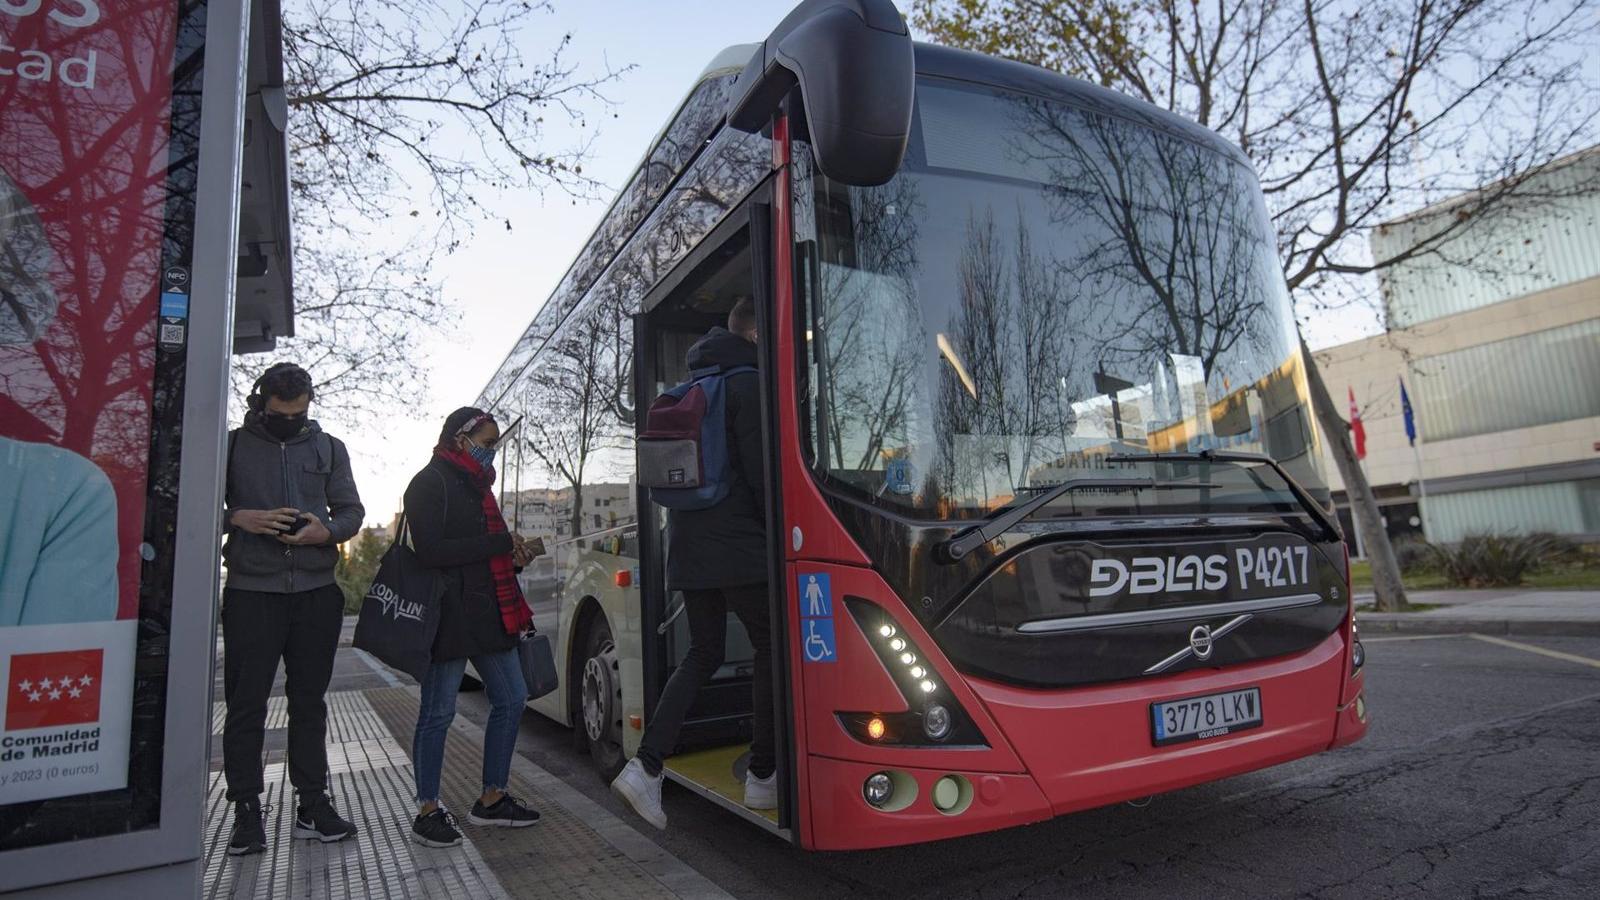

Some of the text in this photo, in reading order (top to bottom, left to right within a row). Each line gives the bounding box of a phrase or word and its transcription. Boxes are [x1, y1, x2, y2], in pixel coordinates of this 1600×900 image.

[168, 272, 186, 280] NFC
[1235, 546, 1308, 590] P4217
[1166, 692, 1255, 733] 3778 LKW
[2, 727, 101, 748] Comunidad
[1, 740, 99, 762] de Madrid
[12, 770, 42, 783] 2023
[62, 763, 99, 778] euros)
